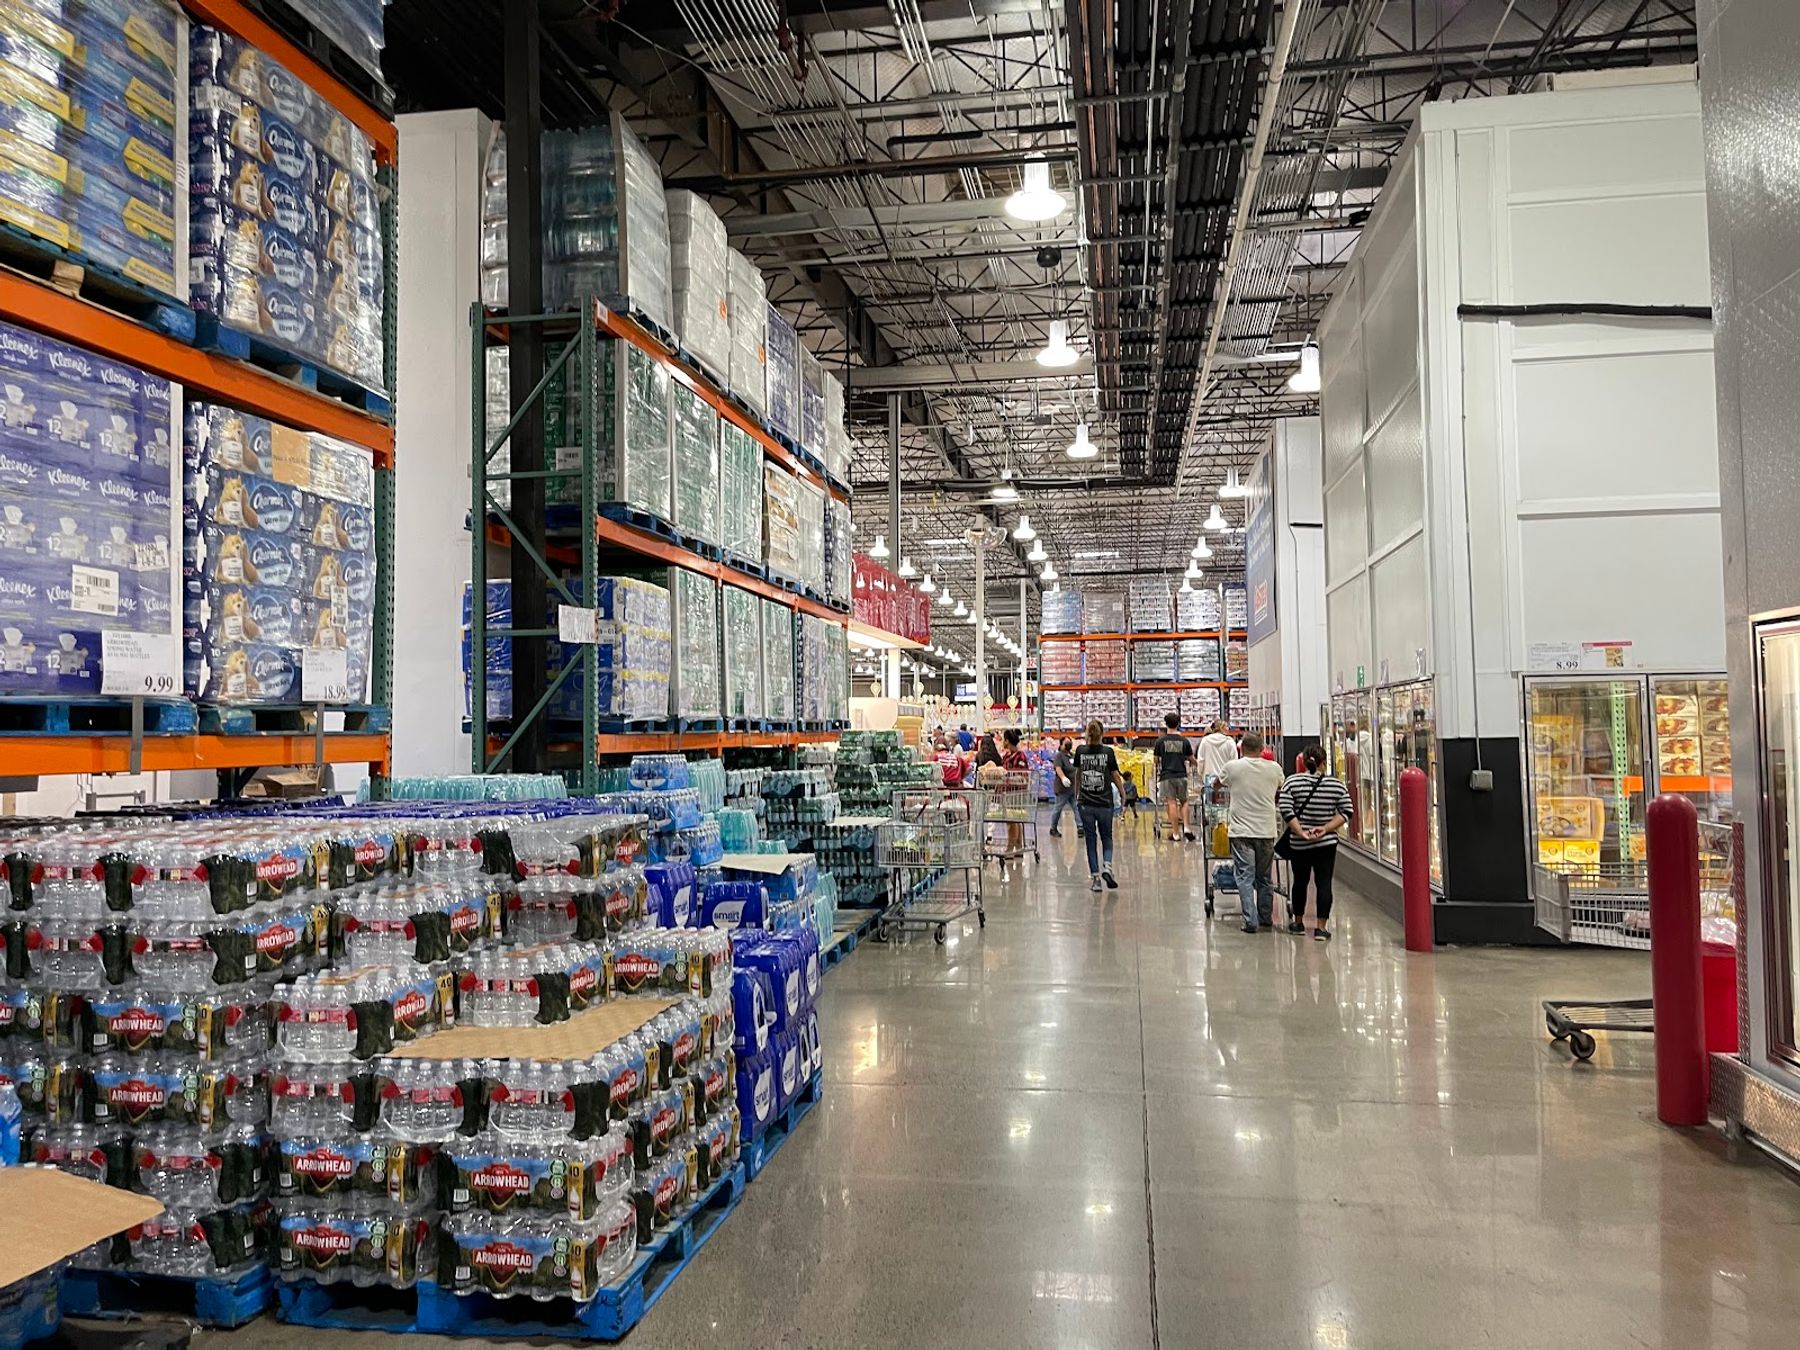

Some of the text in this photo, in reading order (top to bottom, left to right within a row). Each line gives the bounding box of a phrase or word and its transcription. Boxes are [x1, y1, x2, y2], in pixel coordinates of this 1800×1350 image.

[0, 334, 39, 359] leenex
[49, 352, 92, 377] Kleenex
[101, 368, 140, 393] Kleenex
[144, 384, 170, 401] Kleen
[47, 418, 62, 435] 12
[99, 433, 113, 448] 12
[143, 445, 156, 459] 12
[0, 455, 38, 478] leenex
[48, 468, 91, 491] Kleenex
[99, 480, 139, 502] Kleenex
[144, 490, 170, 507] Kleen
[207, 527, 218, 536] 30
[46, 536, 61, 551] 12
[97, 545, 112, 559] 12
[0, 577, 37, 598] leenex
[46, 586, 73, 604] Kleen
[145, 598, 170, 614] Kleen
[45, 654, 61, 669] 12
[1556, 660, 1579, 670] 8.99
[145, 675, 174, 693] 9.99
[324, 684, 347, 700] 18.99
[714, 911, 740, 921] smart
[691, 954, 700, 964] 40
[614, 962, 659, 974] ARROWHEAD
[112, 1018, 164, 1032] ARROWHEAD
[111, 1089, 164, 1103] ARROWHEAD
[296, 1158, 351, 1173] ARROWHEAD
[474, 1174, 529, 1188] ARROWHEAD
[296, 1233, 350, 1249] ARROWHEAD
[475, 1251, 532, 1267] ARROWHEAD
